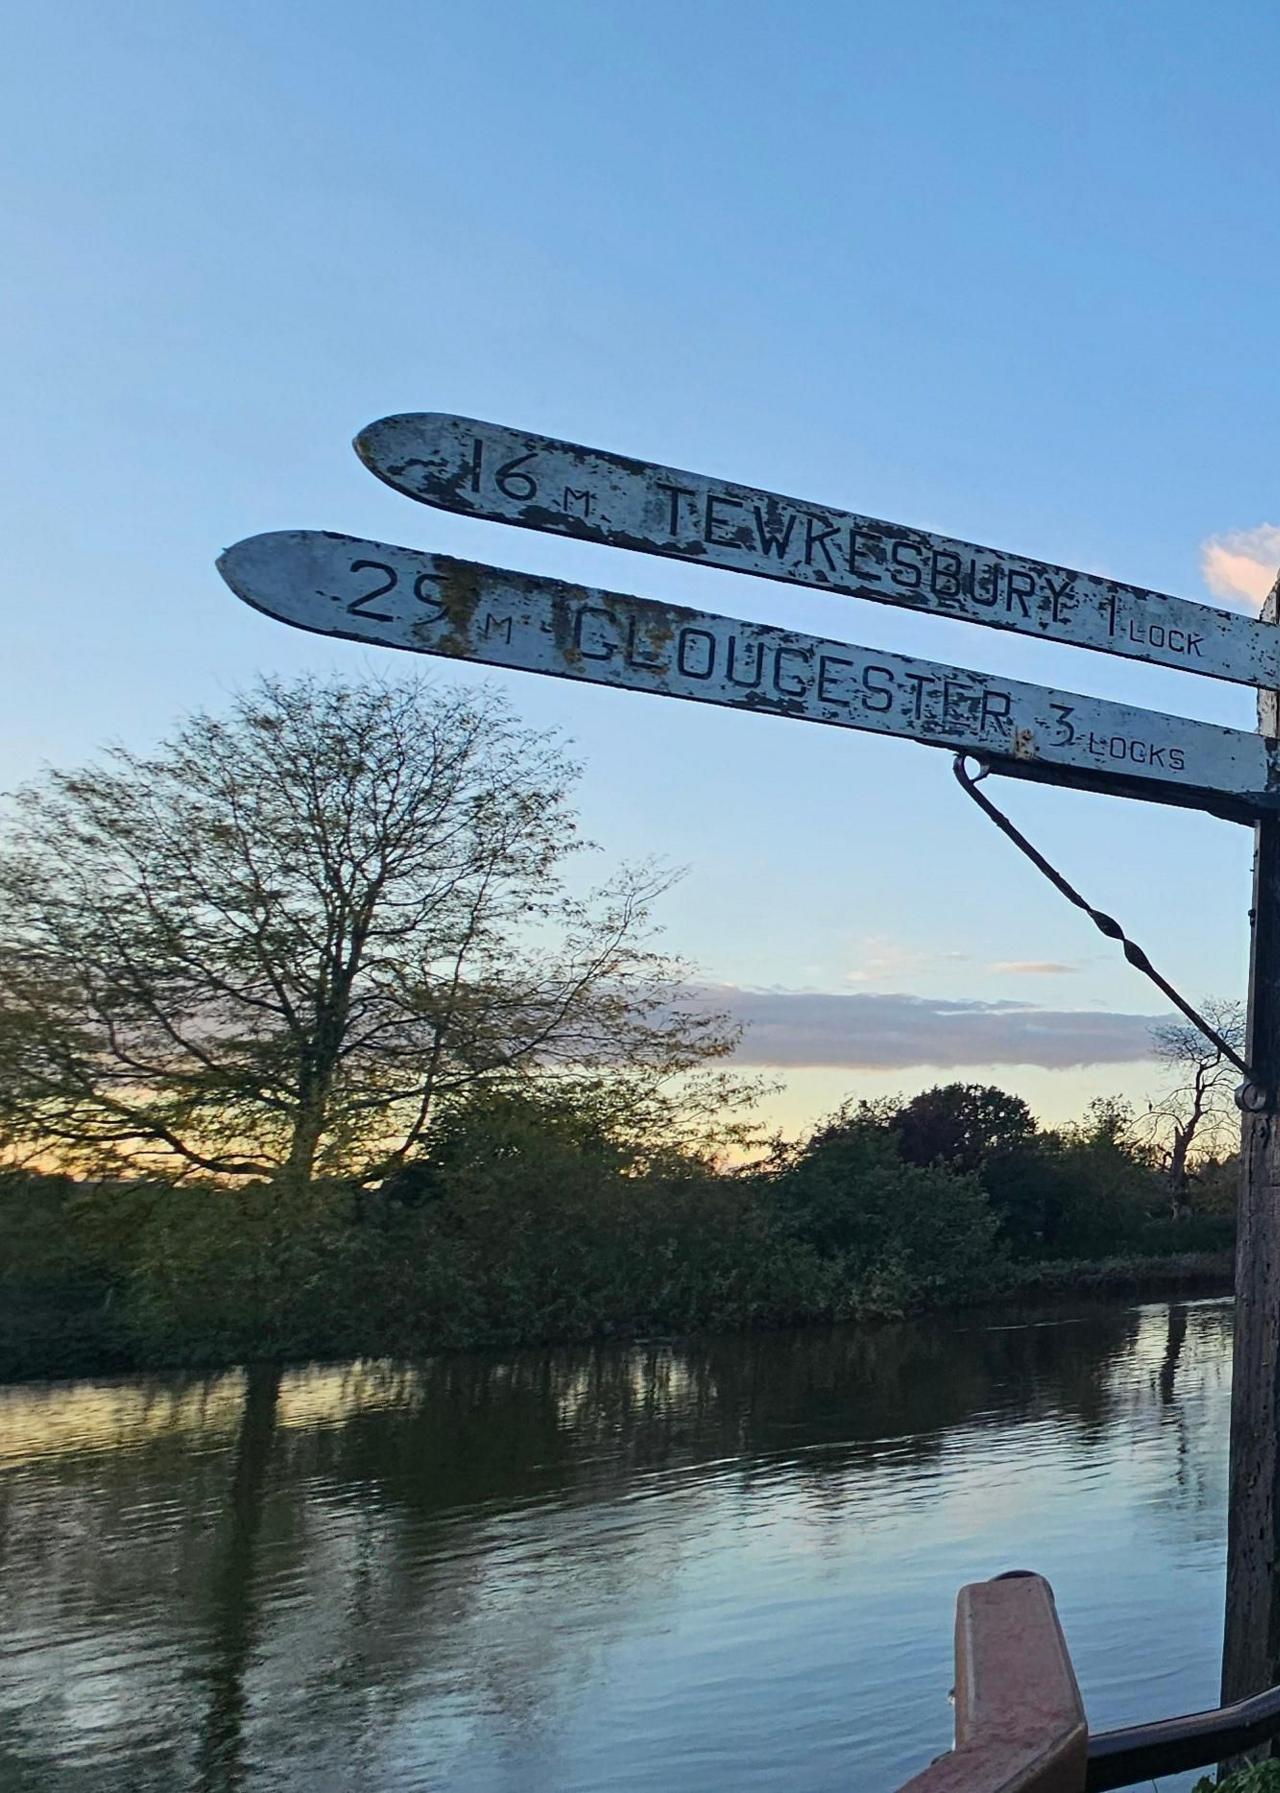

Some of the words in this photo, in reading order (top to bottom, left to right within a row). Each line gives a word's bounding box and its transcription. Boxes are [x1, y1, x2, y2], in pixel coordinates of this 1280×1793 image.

[471, 439, 538, 501] 16
[563, 486, 591, 518] M
[655, 481, 1071, 623] TEWKESBURY
[1128, 619, 1205, 657] LOCK
[484, 612, 513, 646] M
[573, 605, 1012, 737] GLOUCESTER
[1048, 702, 1076, 747] 3
[1088, 732, 1186, 771] LOCKS
